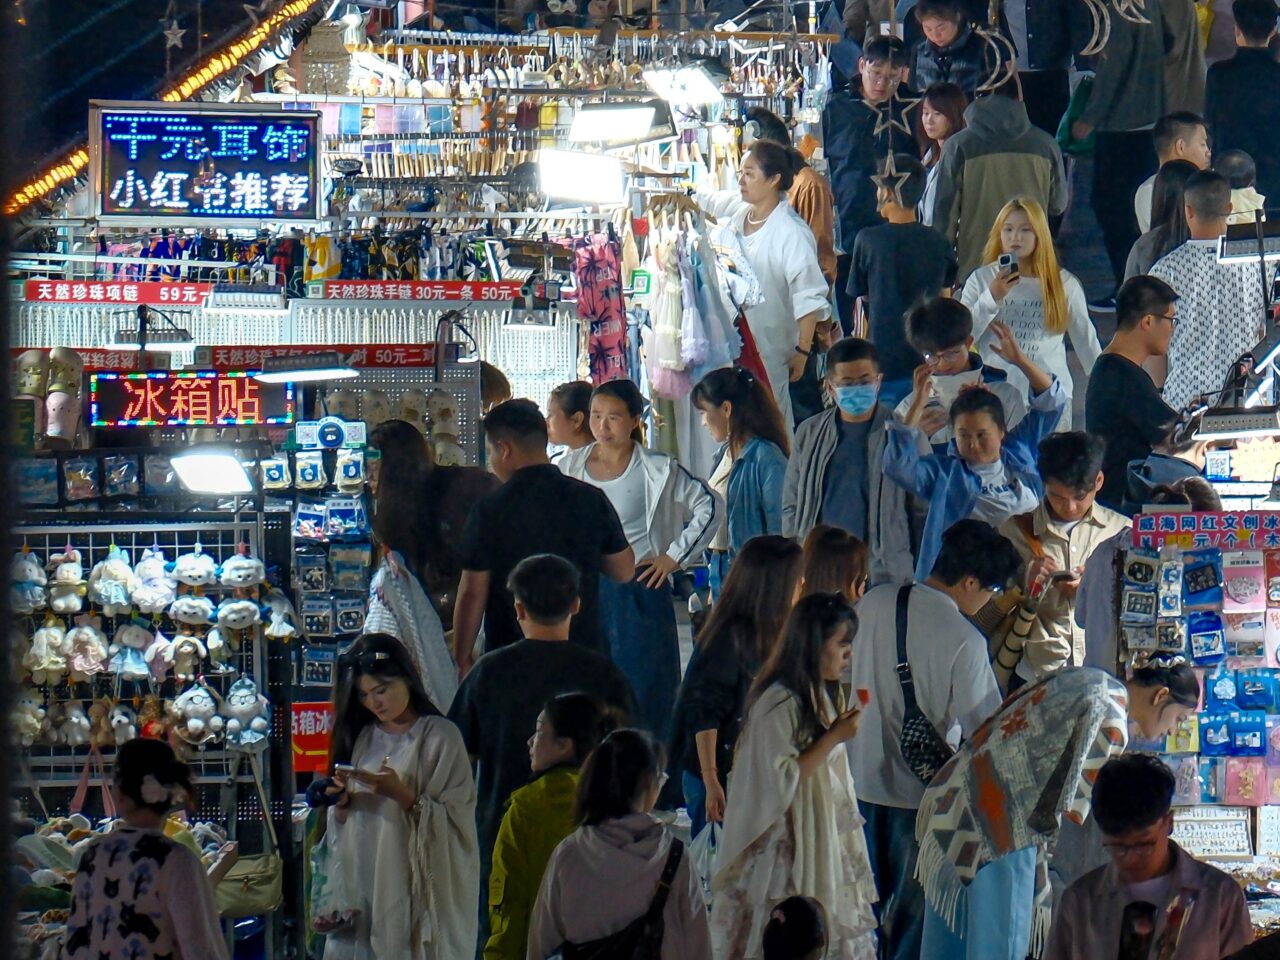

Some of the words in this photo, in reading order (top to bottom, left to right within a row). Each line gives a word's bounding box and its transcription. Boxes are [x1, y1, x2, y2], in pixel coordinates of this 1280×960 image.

[38, 283, 138, 302] 天然珍珠项链
[328, 283, 414, 300] 天然珍珠手链
[124, 378, 261, 424] 冰箱贴
